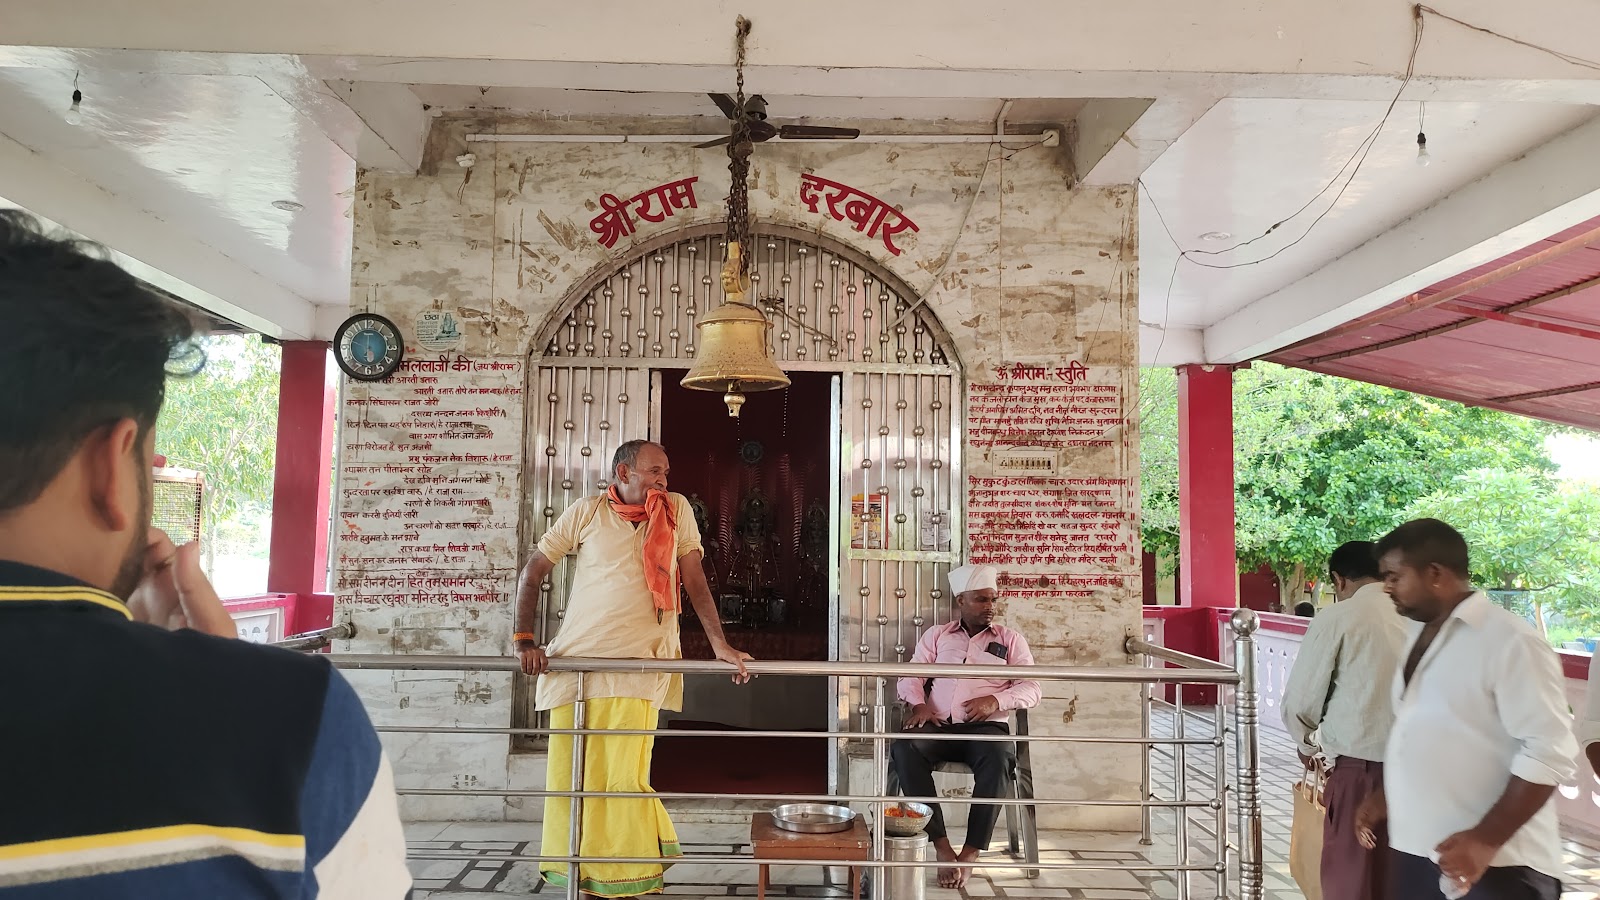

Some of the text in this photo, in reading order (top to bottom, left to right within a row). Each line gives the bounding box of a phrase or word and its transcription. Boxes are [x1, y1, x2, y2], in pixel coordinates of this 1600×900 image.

[590, 173, 920, 257] श्रीराम दरबार
[353, 322, 362, 332] 11
[364, 320, 374, 329] 12
[378, 324, 384, 332] 1
[344, 331, 353, 340] 10
[384, 333, 394, 341] 2
[385, 356, 393, 364] 4
[452, 355, 473, 373] की
[354, 363, 362, 372] 7
[365, 366, 371, 375] 6
[376, 363, 384, 372] 5
[996, 366, 1008, 380] ॐ
[1055, 360, 1089, 384] स्तुति
[424, 498, 431, 507] से
